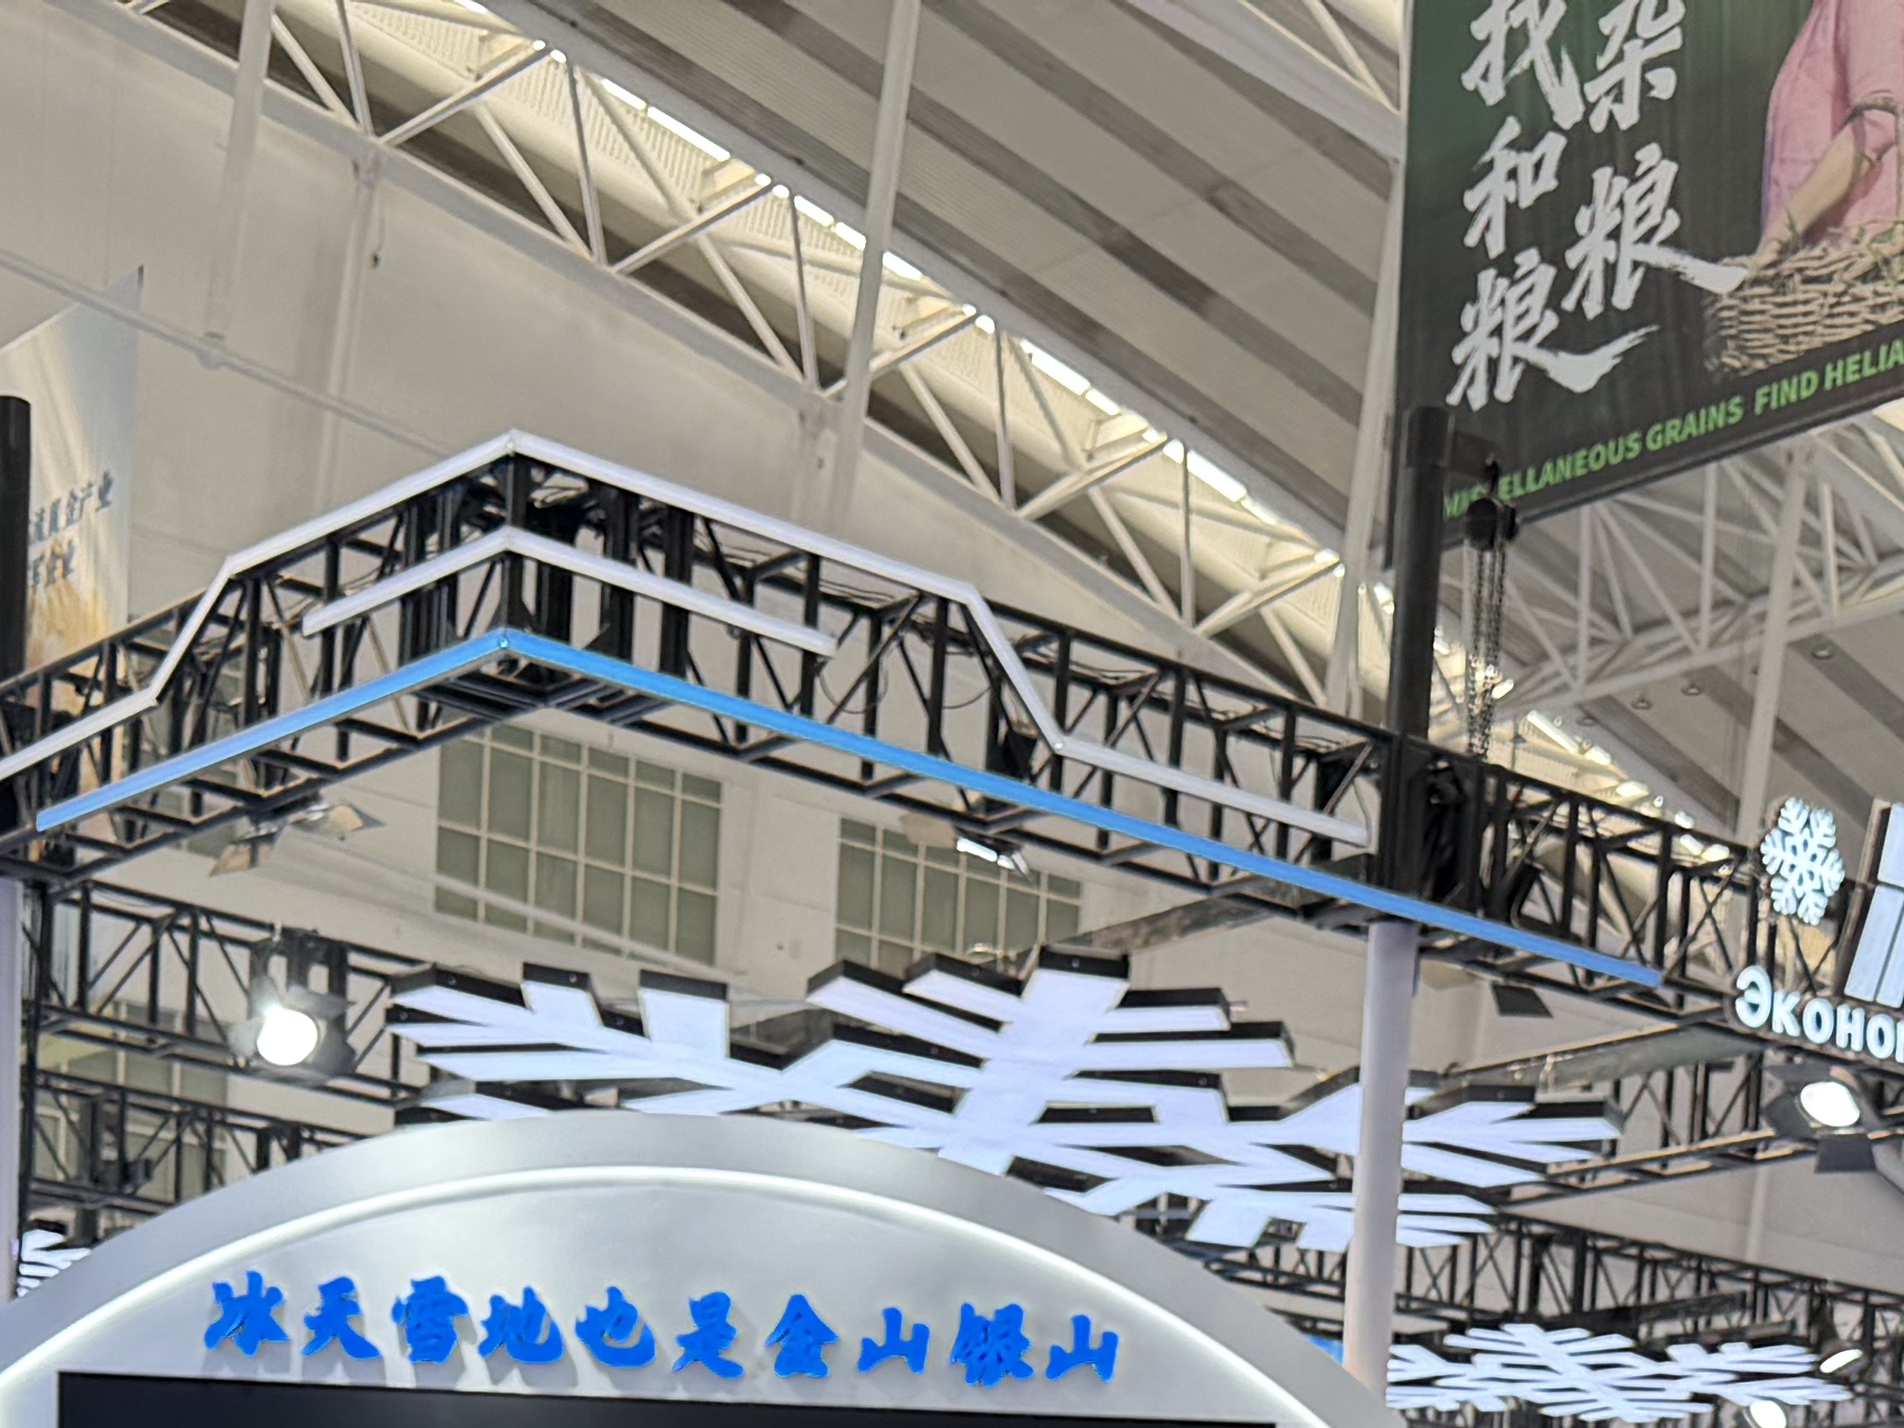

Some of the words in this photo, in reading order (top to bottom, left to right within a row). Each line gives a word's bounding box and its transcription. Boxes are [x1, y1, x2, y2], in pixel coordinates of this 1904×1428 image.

[1645, 395, 1744, 453] GRAINS
[1753, 369, 1819, 416] FIND
[203, 1270, 1120, 1388] 冰天雪地也是金山银山
